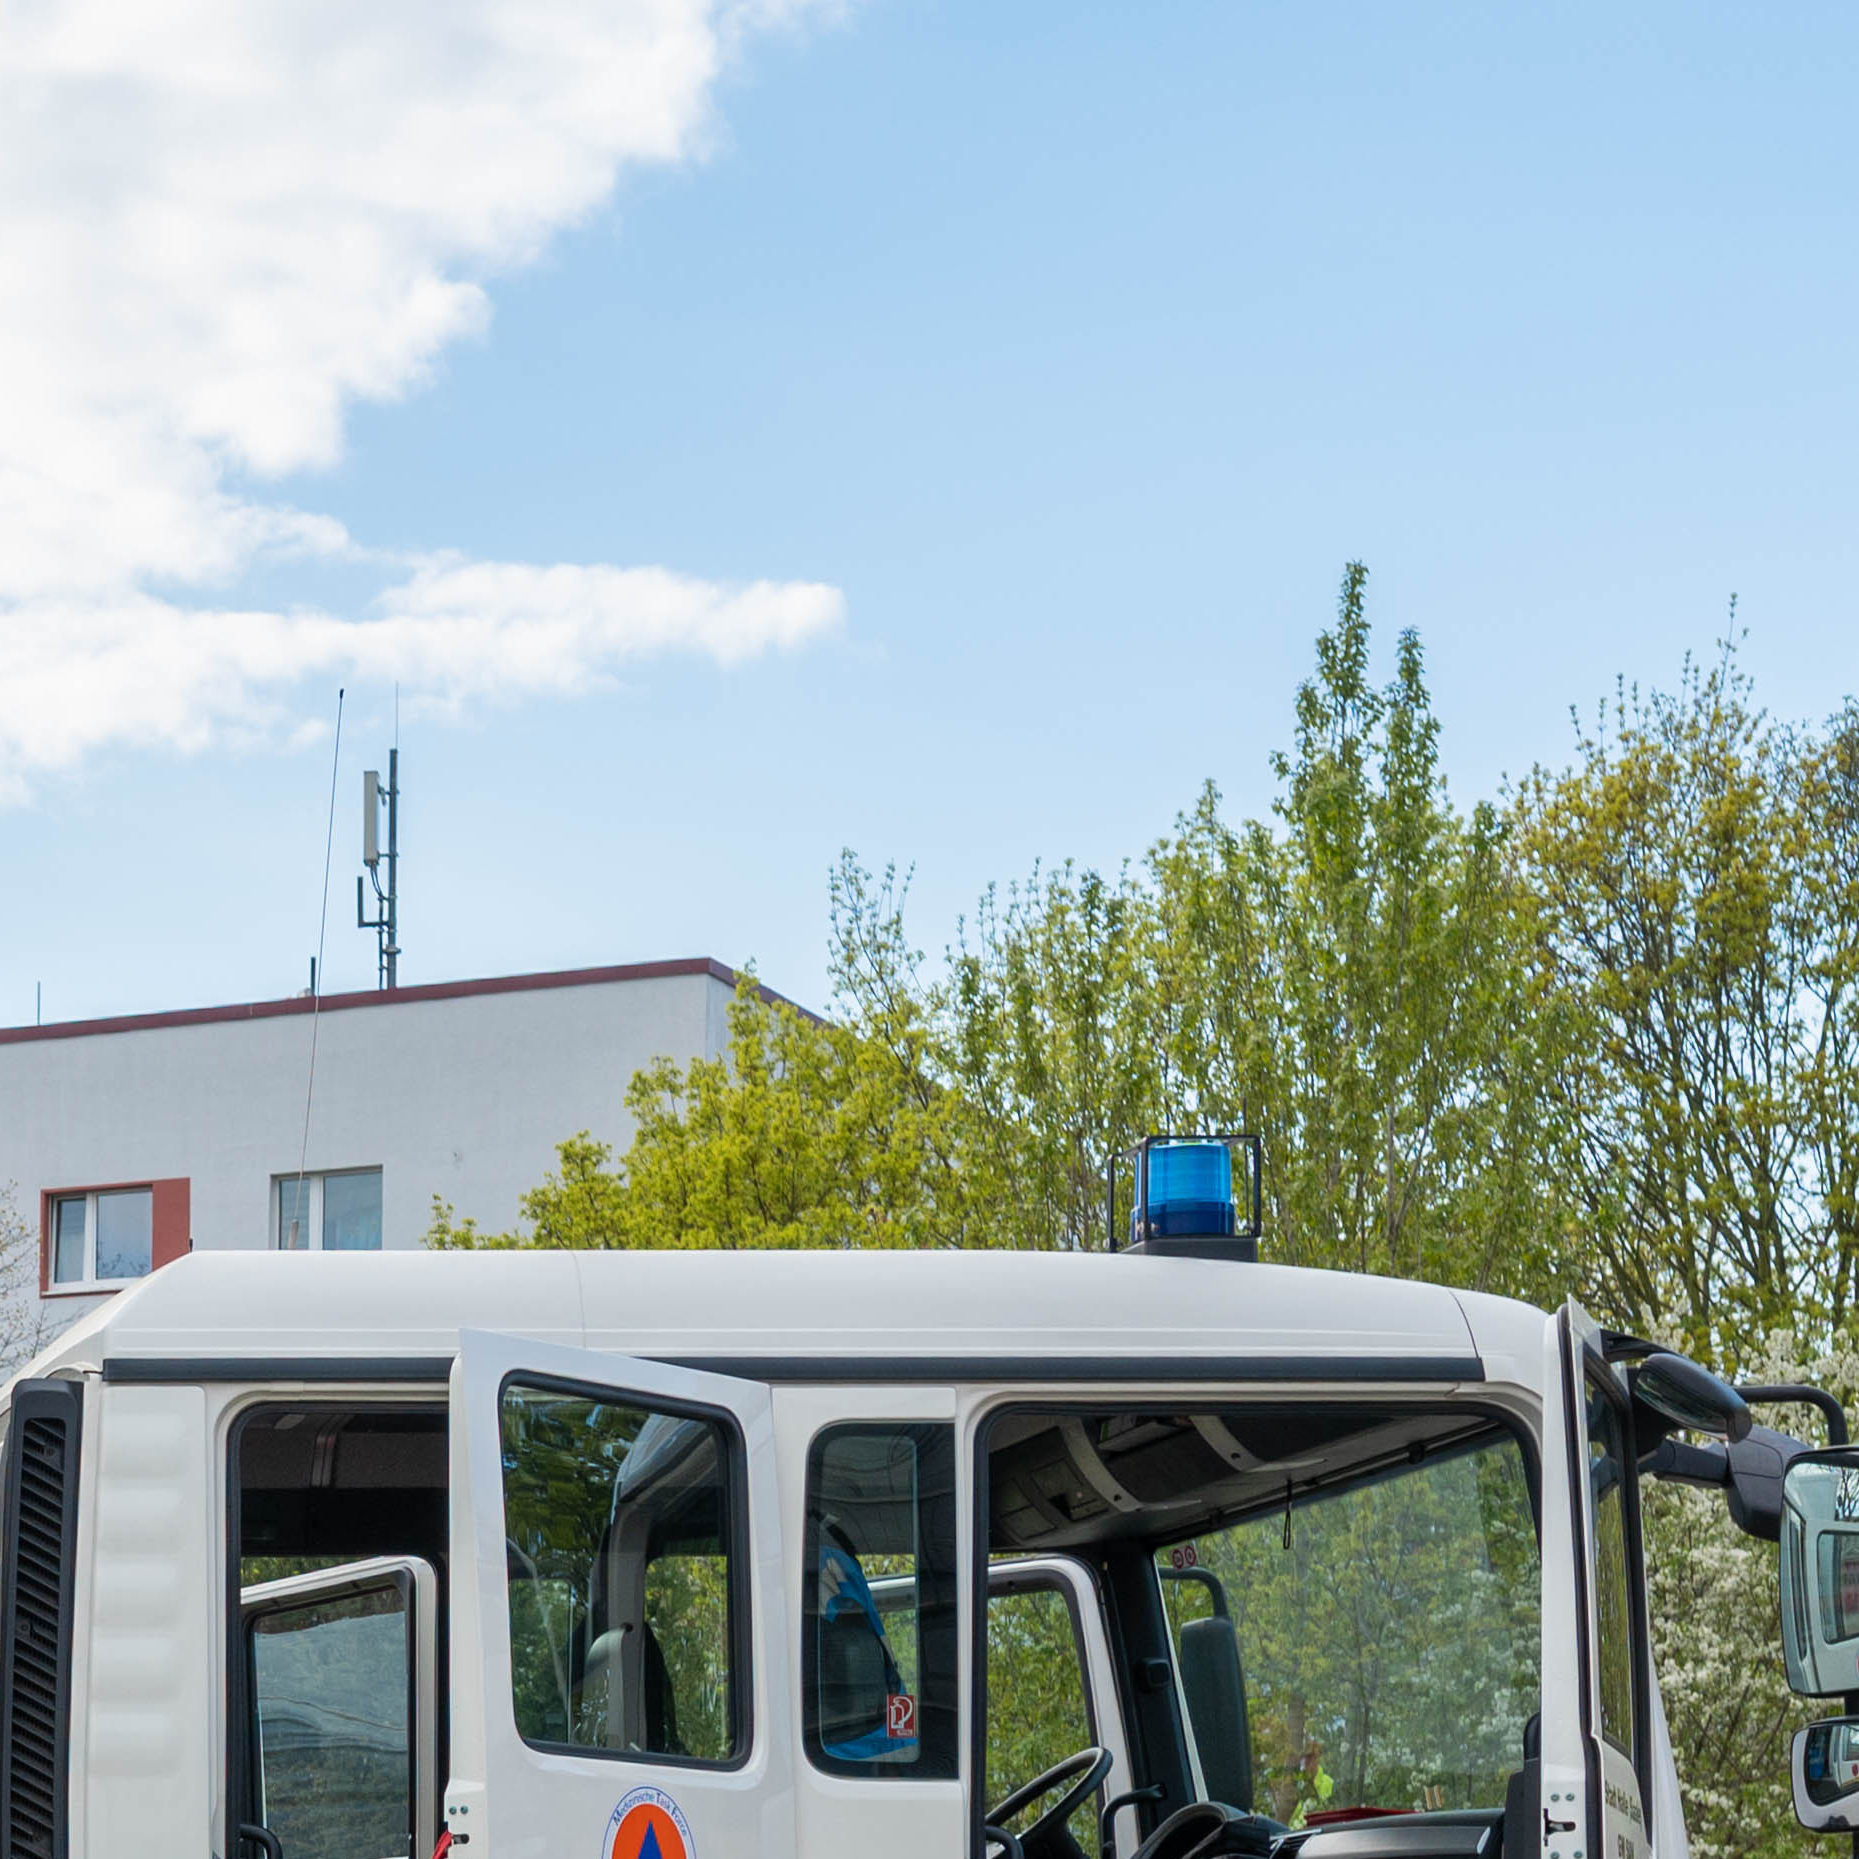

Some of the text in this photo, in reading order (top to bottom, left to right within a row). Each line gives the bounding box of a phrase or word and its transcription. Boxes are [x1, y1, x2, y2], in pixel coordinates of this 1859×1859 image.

[613, 1790, 688, 1837] Medizinische Task Force
